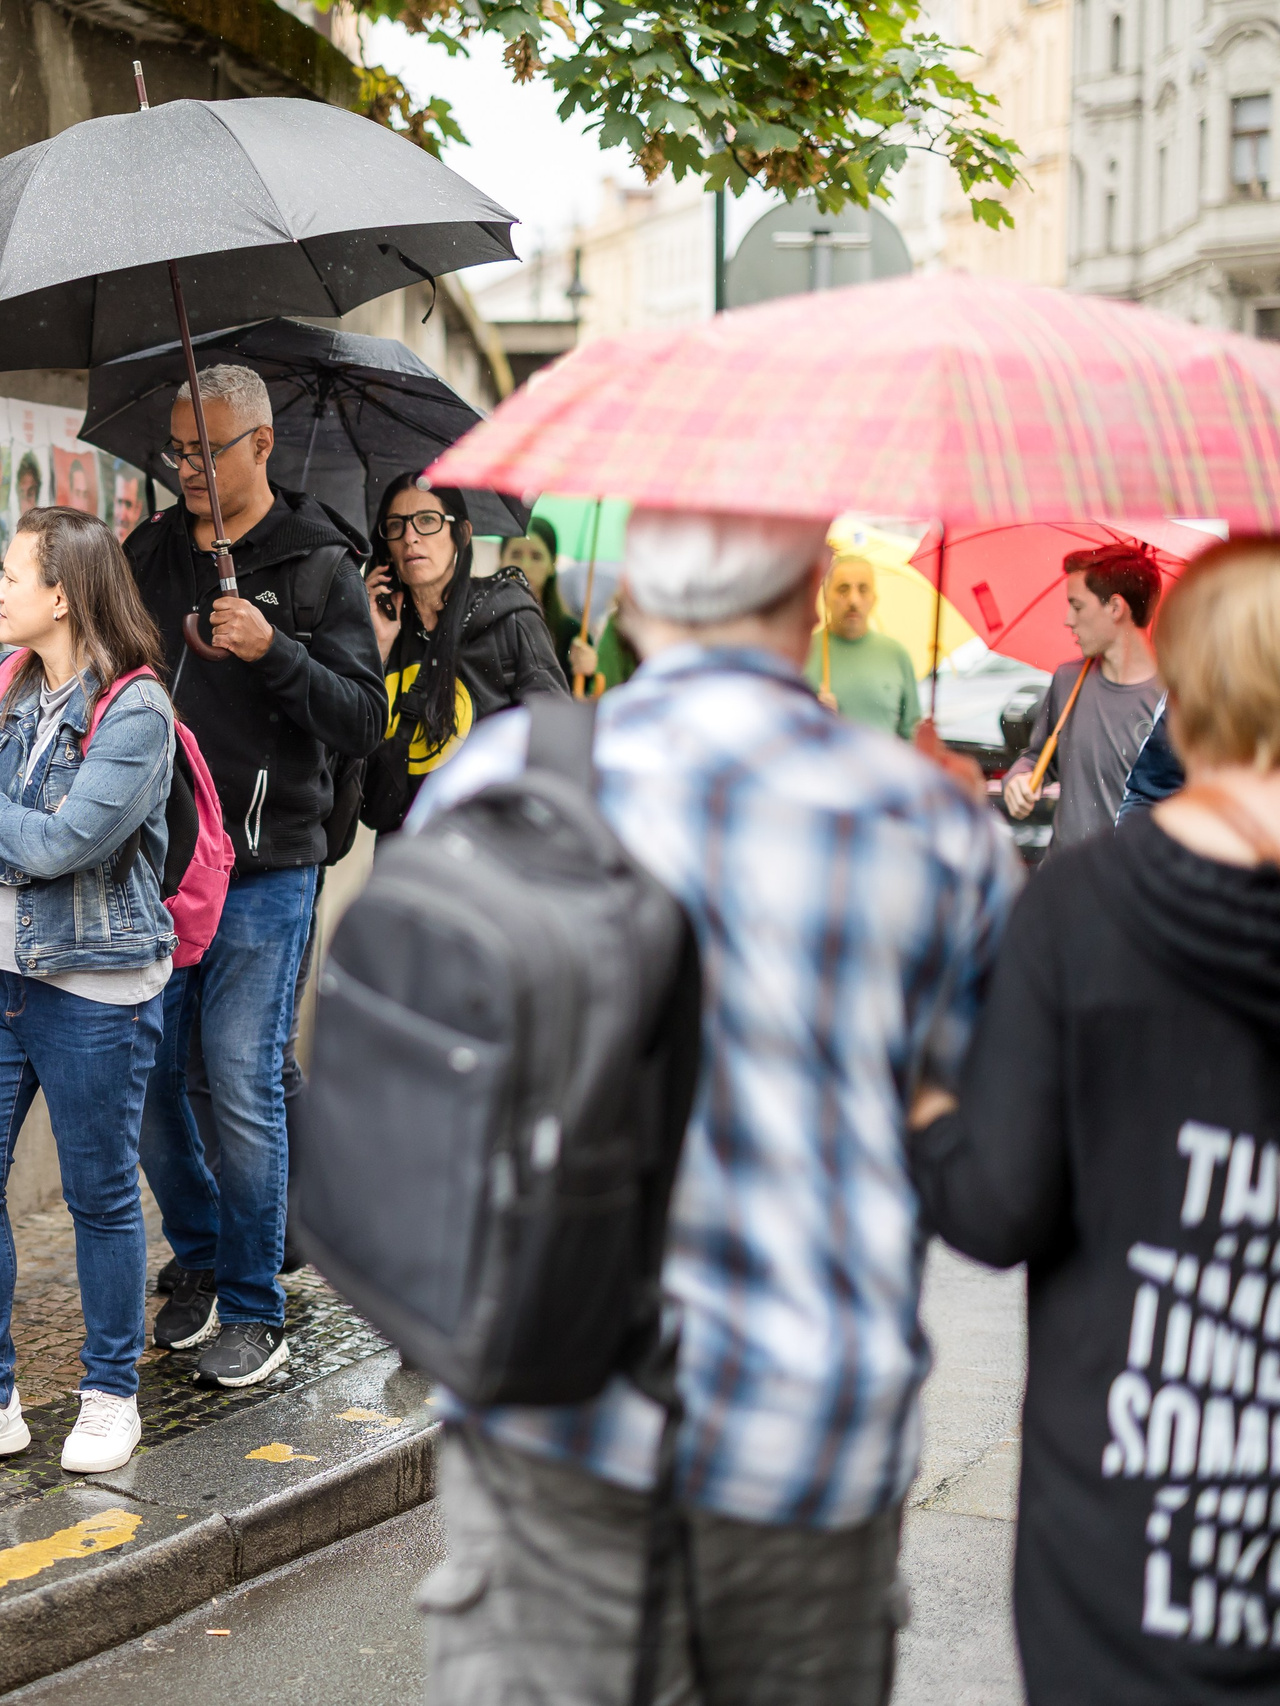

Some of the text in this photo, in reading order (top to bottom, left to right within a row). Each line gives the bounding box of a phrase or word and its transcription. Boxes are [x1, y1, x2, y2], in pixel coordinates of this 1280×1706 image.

[1177, 1117, 1280, 1265] TH
[1101, 1368, 1280, 1480] SOM
[1142, 1500, 1280, 1650] LIK
